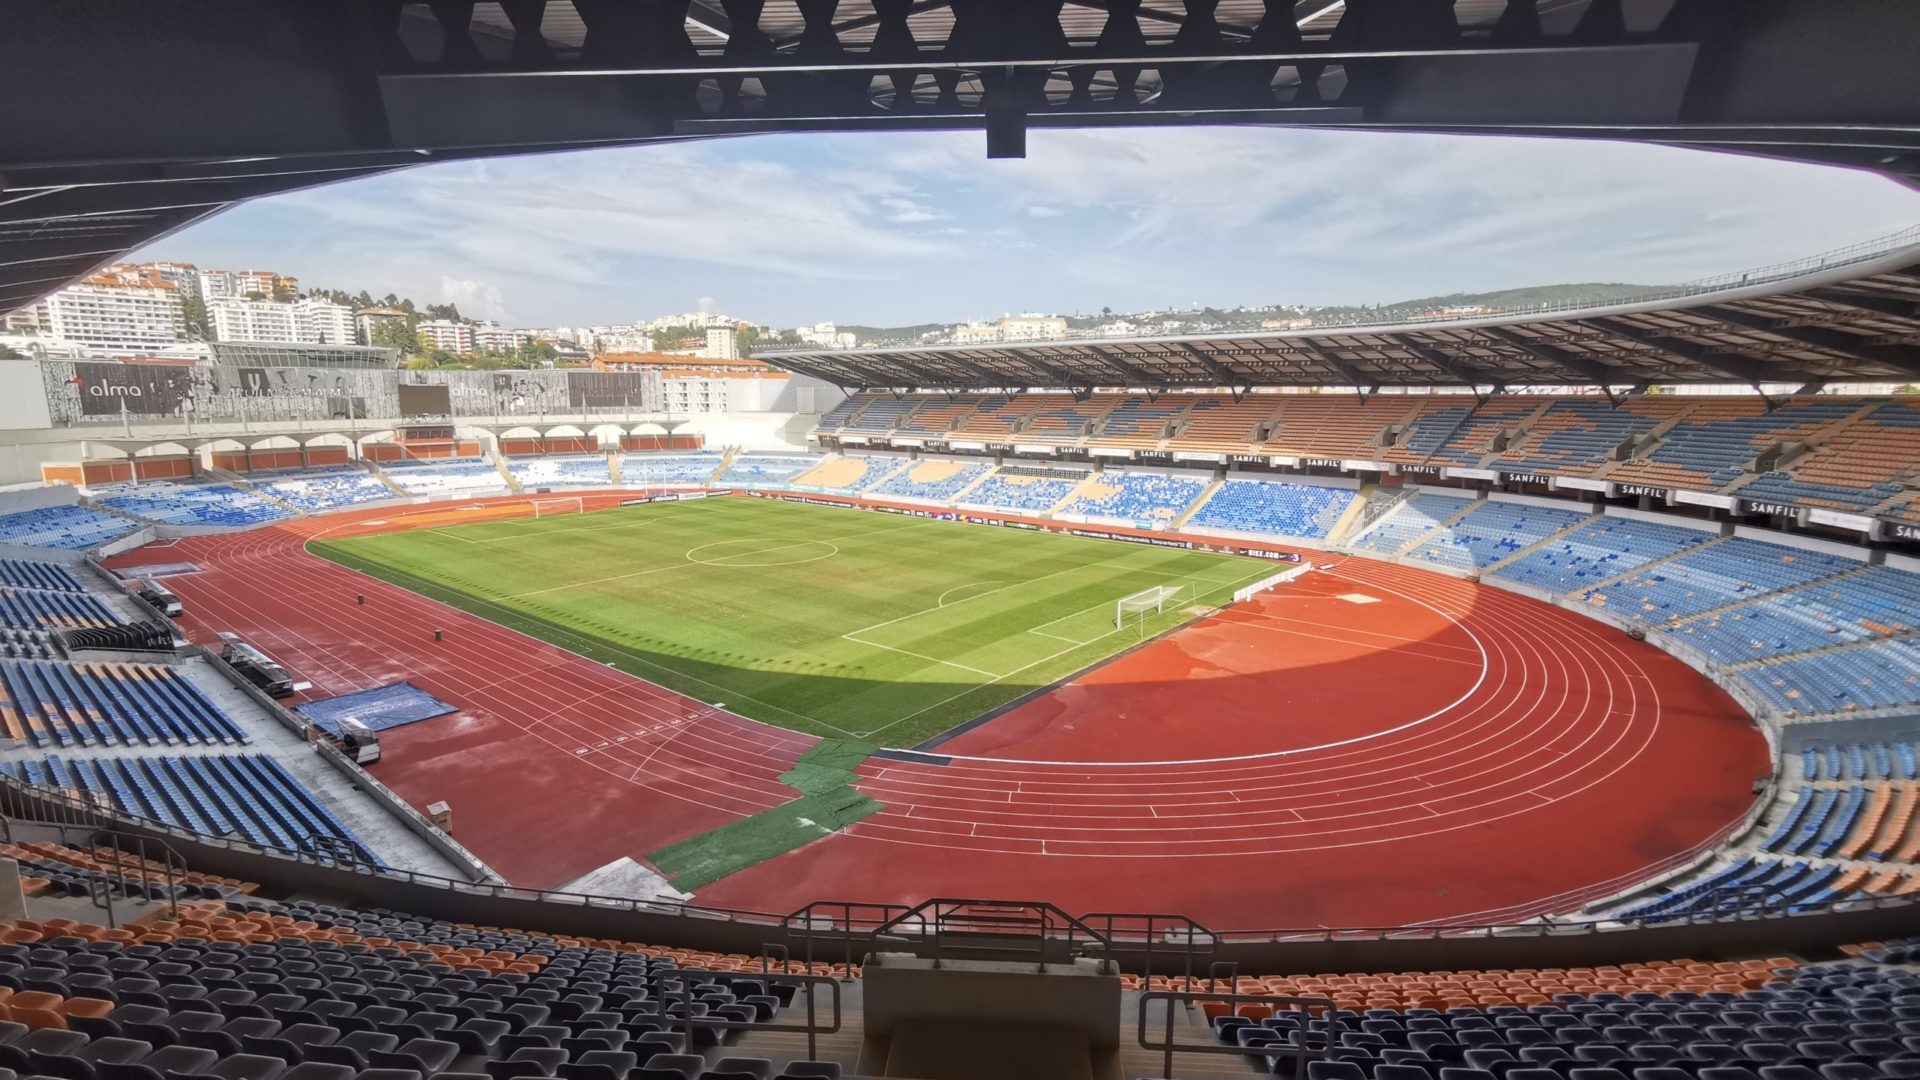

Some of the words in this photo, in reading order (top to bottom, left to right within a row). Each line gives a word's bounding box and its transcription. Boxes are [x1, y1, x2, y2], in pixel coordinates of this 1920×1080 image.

[90, 378, 142, 397] alma
[1232, 455, 1263, 463] SANFIL
[1306, 459, 1338, 467] SANFIL
[1402, 464, 1435, 474] SANFIL
[1509, 473, 1547, 485] SANFIL
[1622, 484, 1662, 498] SANFIL
[1751, 502, 1797, 518] SANFIL
